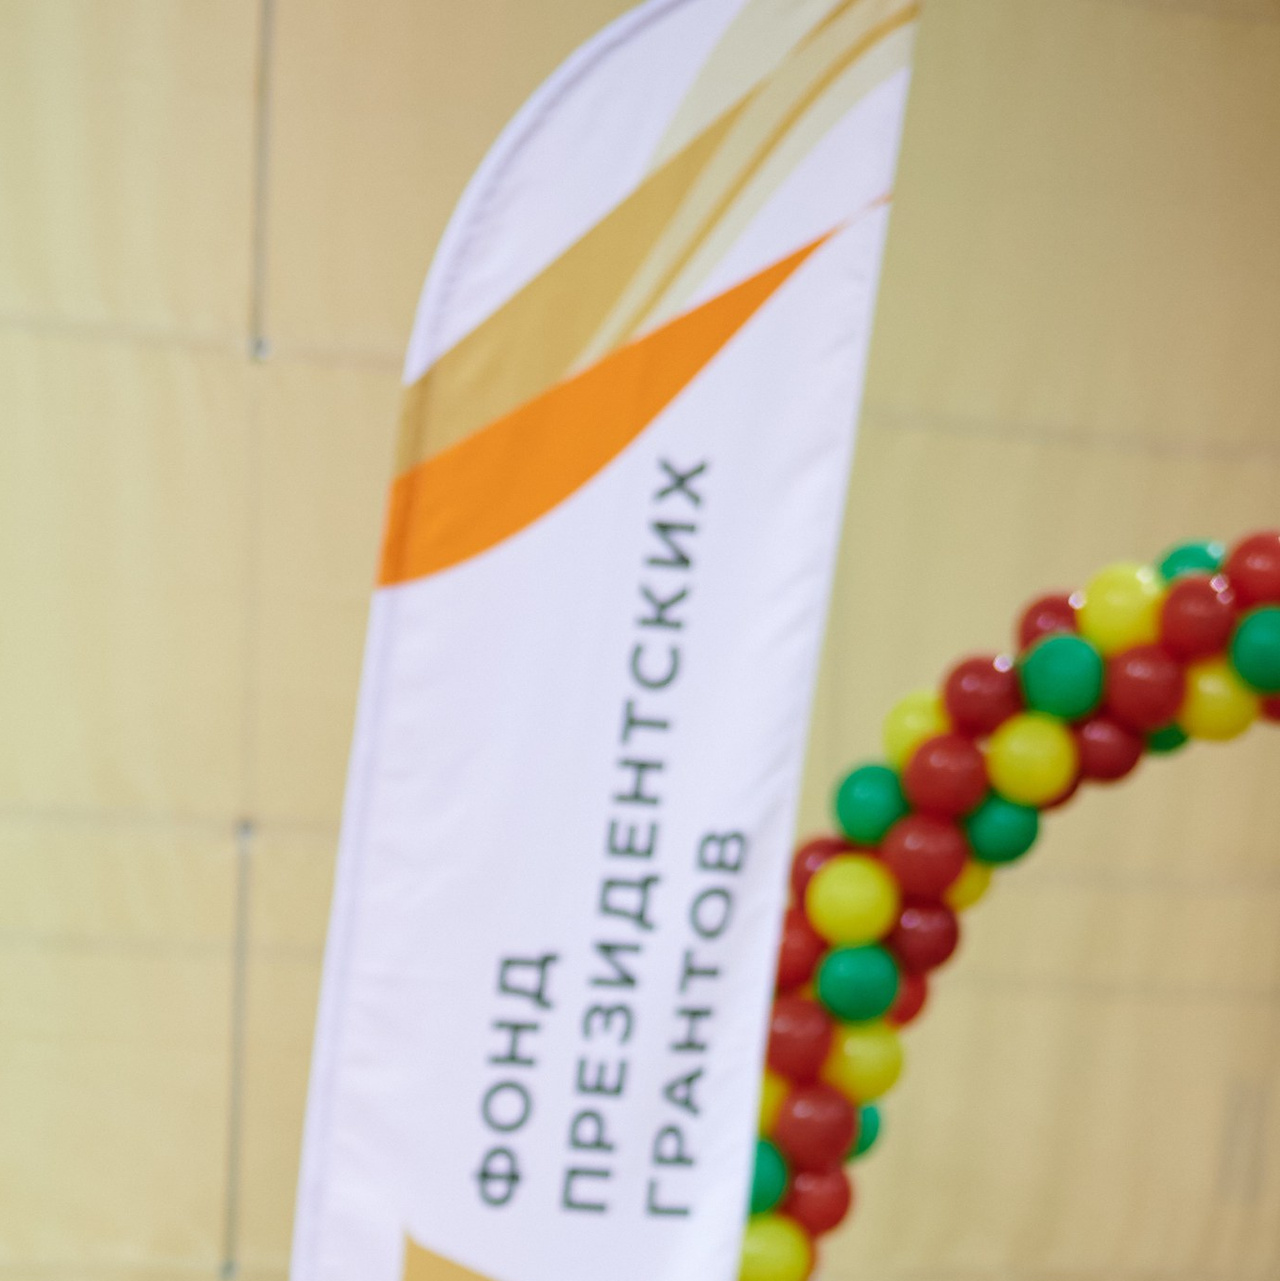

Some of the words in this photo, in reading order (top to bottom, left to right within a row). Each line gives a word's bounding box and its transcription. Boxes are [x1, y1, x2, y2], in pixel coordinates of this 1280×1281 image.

[561, 457, 709, 1214] ПРЕЗИДЕНТСКИХ
[646, 829, 748, 1219] ГРАНТОВ
[474, 951, 560, 1208] ФОНД
